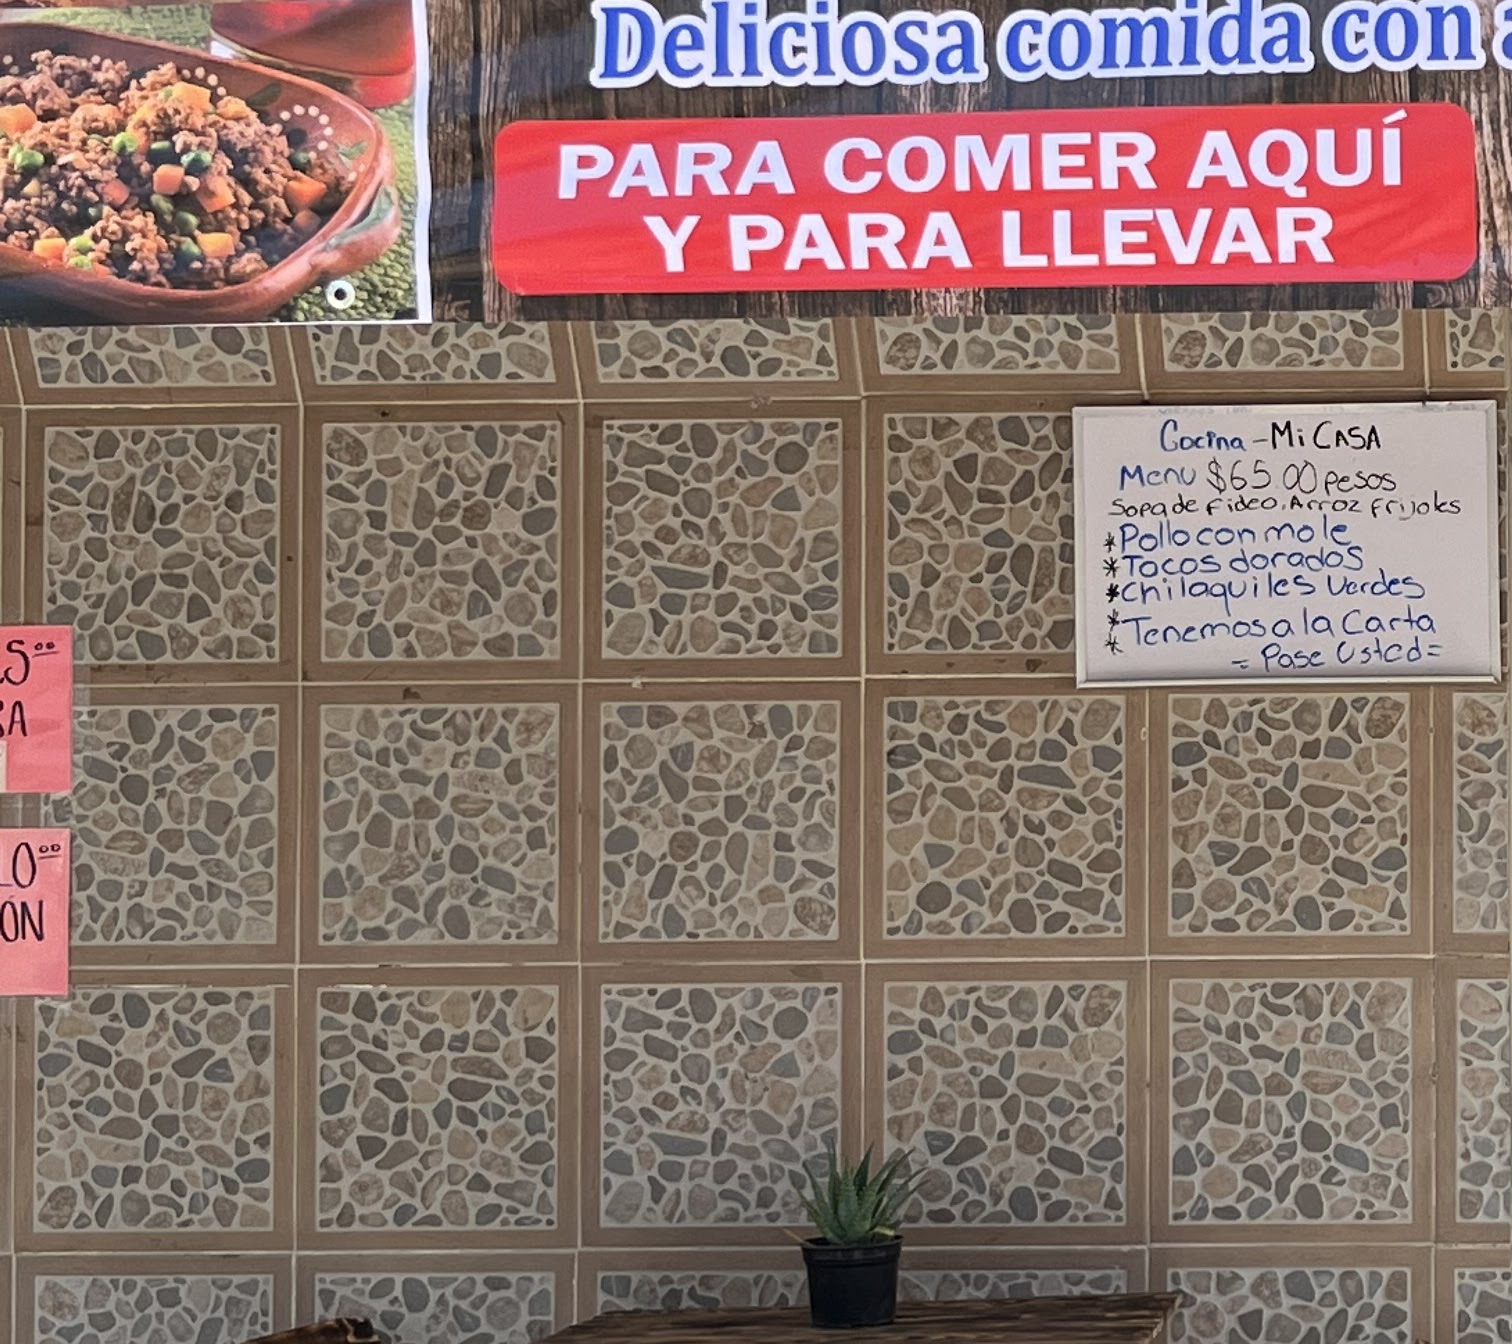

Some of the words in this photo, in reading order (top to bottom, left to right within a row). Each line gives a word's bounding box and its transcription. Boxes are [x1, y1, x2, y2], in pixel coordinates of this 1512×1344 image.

[557, 140, 798, 200] PARA
[823, 130, 1157, 194] COMER
[1185, 108, 1408, 199] AQUÍ
[642, 215, 696, 273] Y
[731, 211, 973, 271] PARA
[1001, 206, 1335, 267] LLEVAR
[1160, 418, 1246, 452] Cocina
[1313, 420, 1382, 451] CASA
[1119, 464, 1197, 491] Menu
[1324, 470, 1397, 496] pesos
[1108, 498, 1168, 518] Sopa
[1171, 493, 1200, 515] de
[1289, 495, 1363, 513] Arroz
[1119, 519, 1191, 554] Pollo
[1195, 526, 1257, 548] con
[1264, 513, 1352, 547] mole
[1228, 545, 1365, 574] dorados
[1121, 571, 1317, 617] Chilaquiles
[1120, 616, 1267, 646] Tenemos
[1272, 618, 1296, 638] a
[1302, 606, 1336, 639] la
